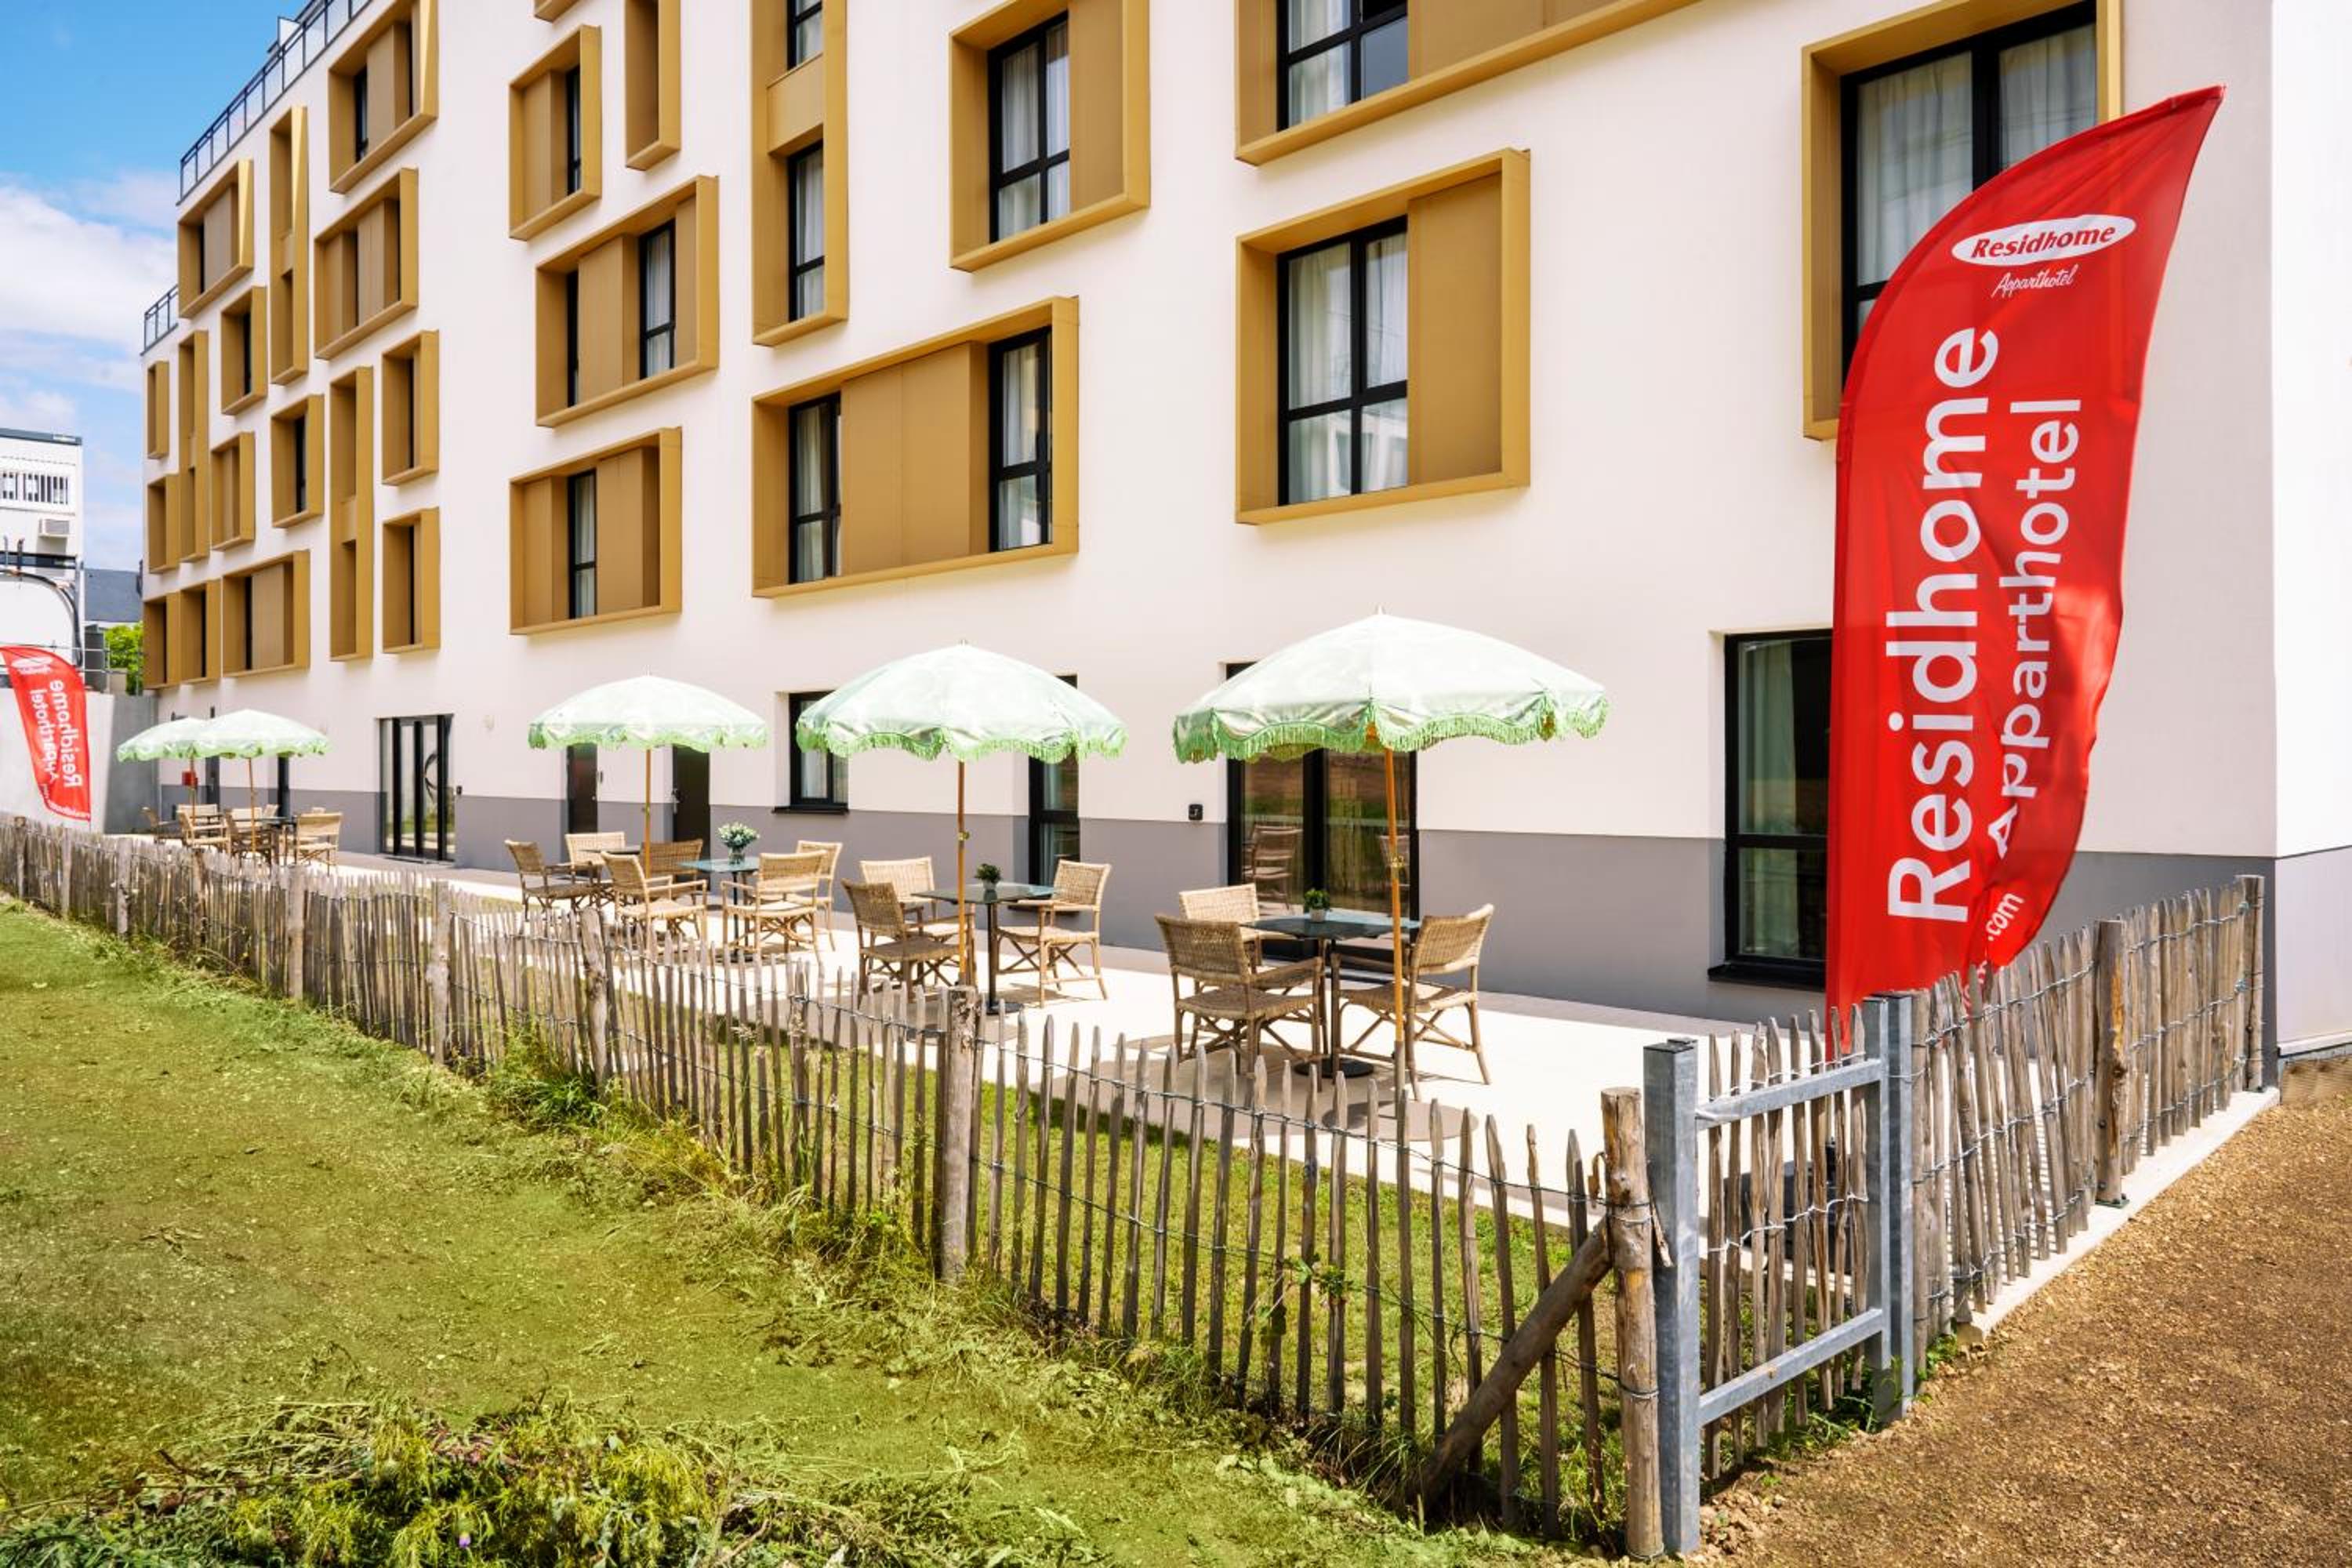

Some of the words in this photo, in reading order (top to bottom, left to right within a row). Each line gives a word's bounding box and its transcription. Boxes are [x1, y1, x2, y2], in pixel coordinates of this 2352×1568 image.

[1971, 225, 2116, 260] Residhome
[1991, 263, 2079, 299] Apparthotel
[1886, 327, 1999, 923] Residhome
[1987, 399, 2082, 859] Apparthotel
